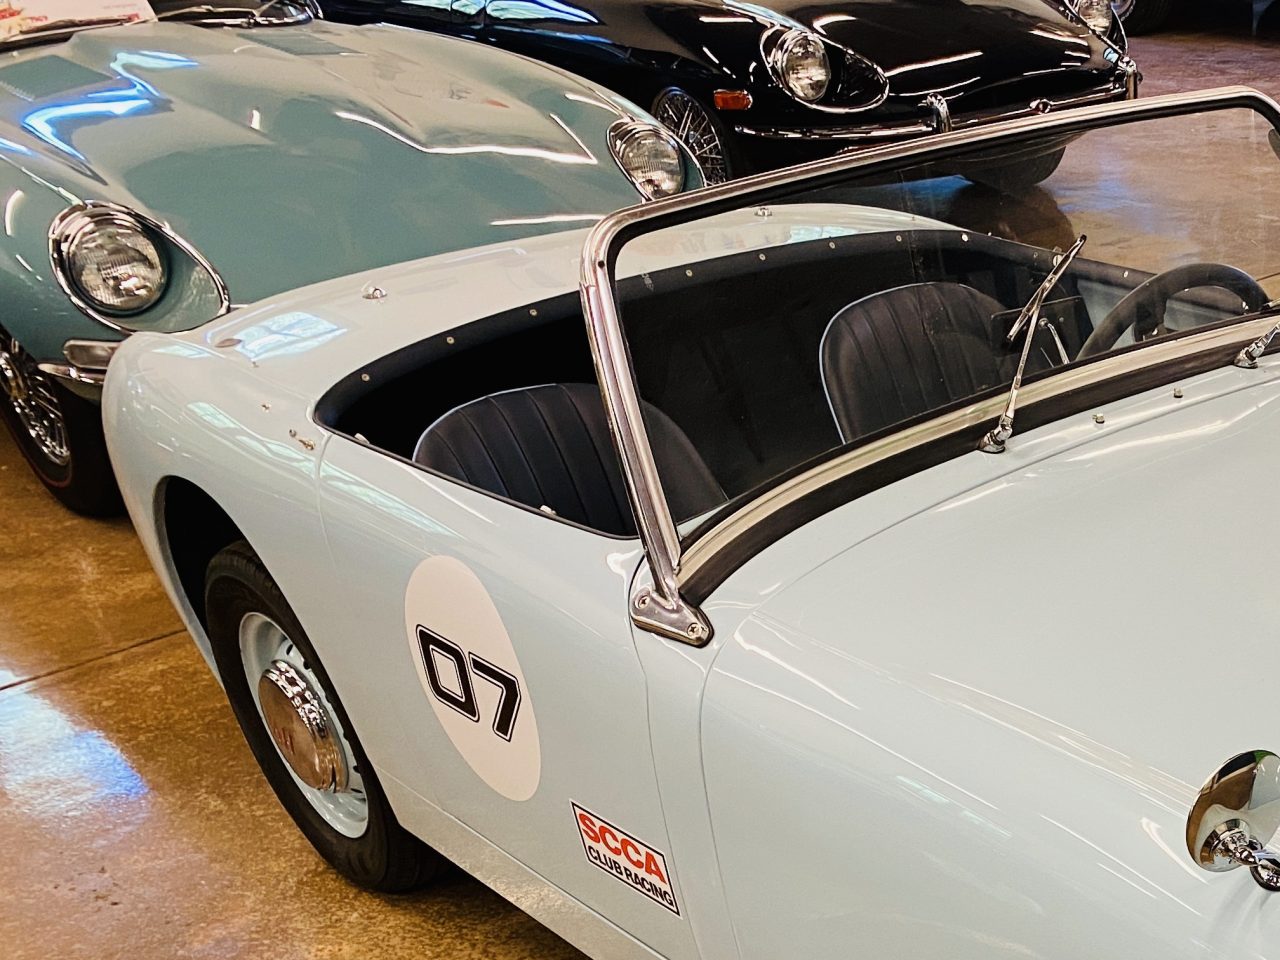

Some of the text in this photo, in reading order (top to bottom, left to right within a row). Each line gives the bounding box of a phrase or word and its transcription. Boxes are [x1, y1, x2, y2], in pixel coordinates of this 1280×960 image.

[415, 623, 522, 743] 07
[578, 812, 667, 885] SCCA
[587, 845, 675, 908] CLUB RACING
